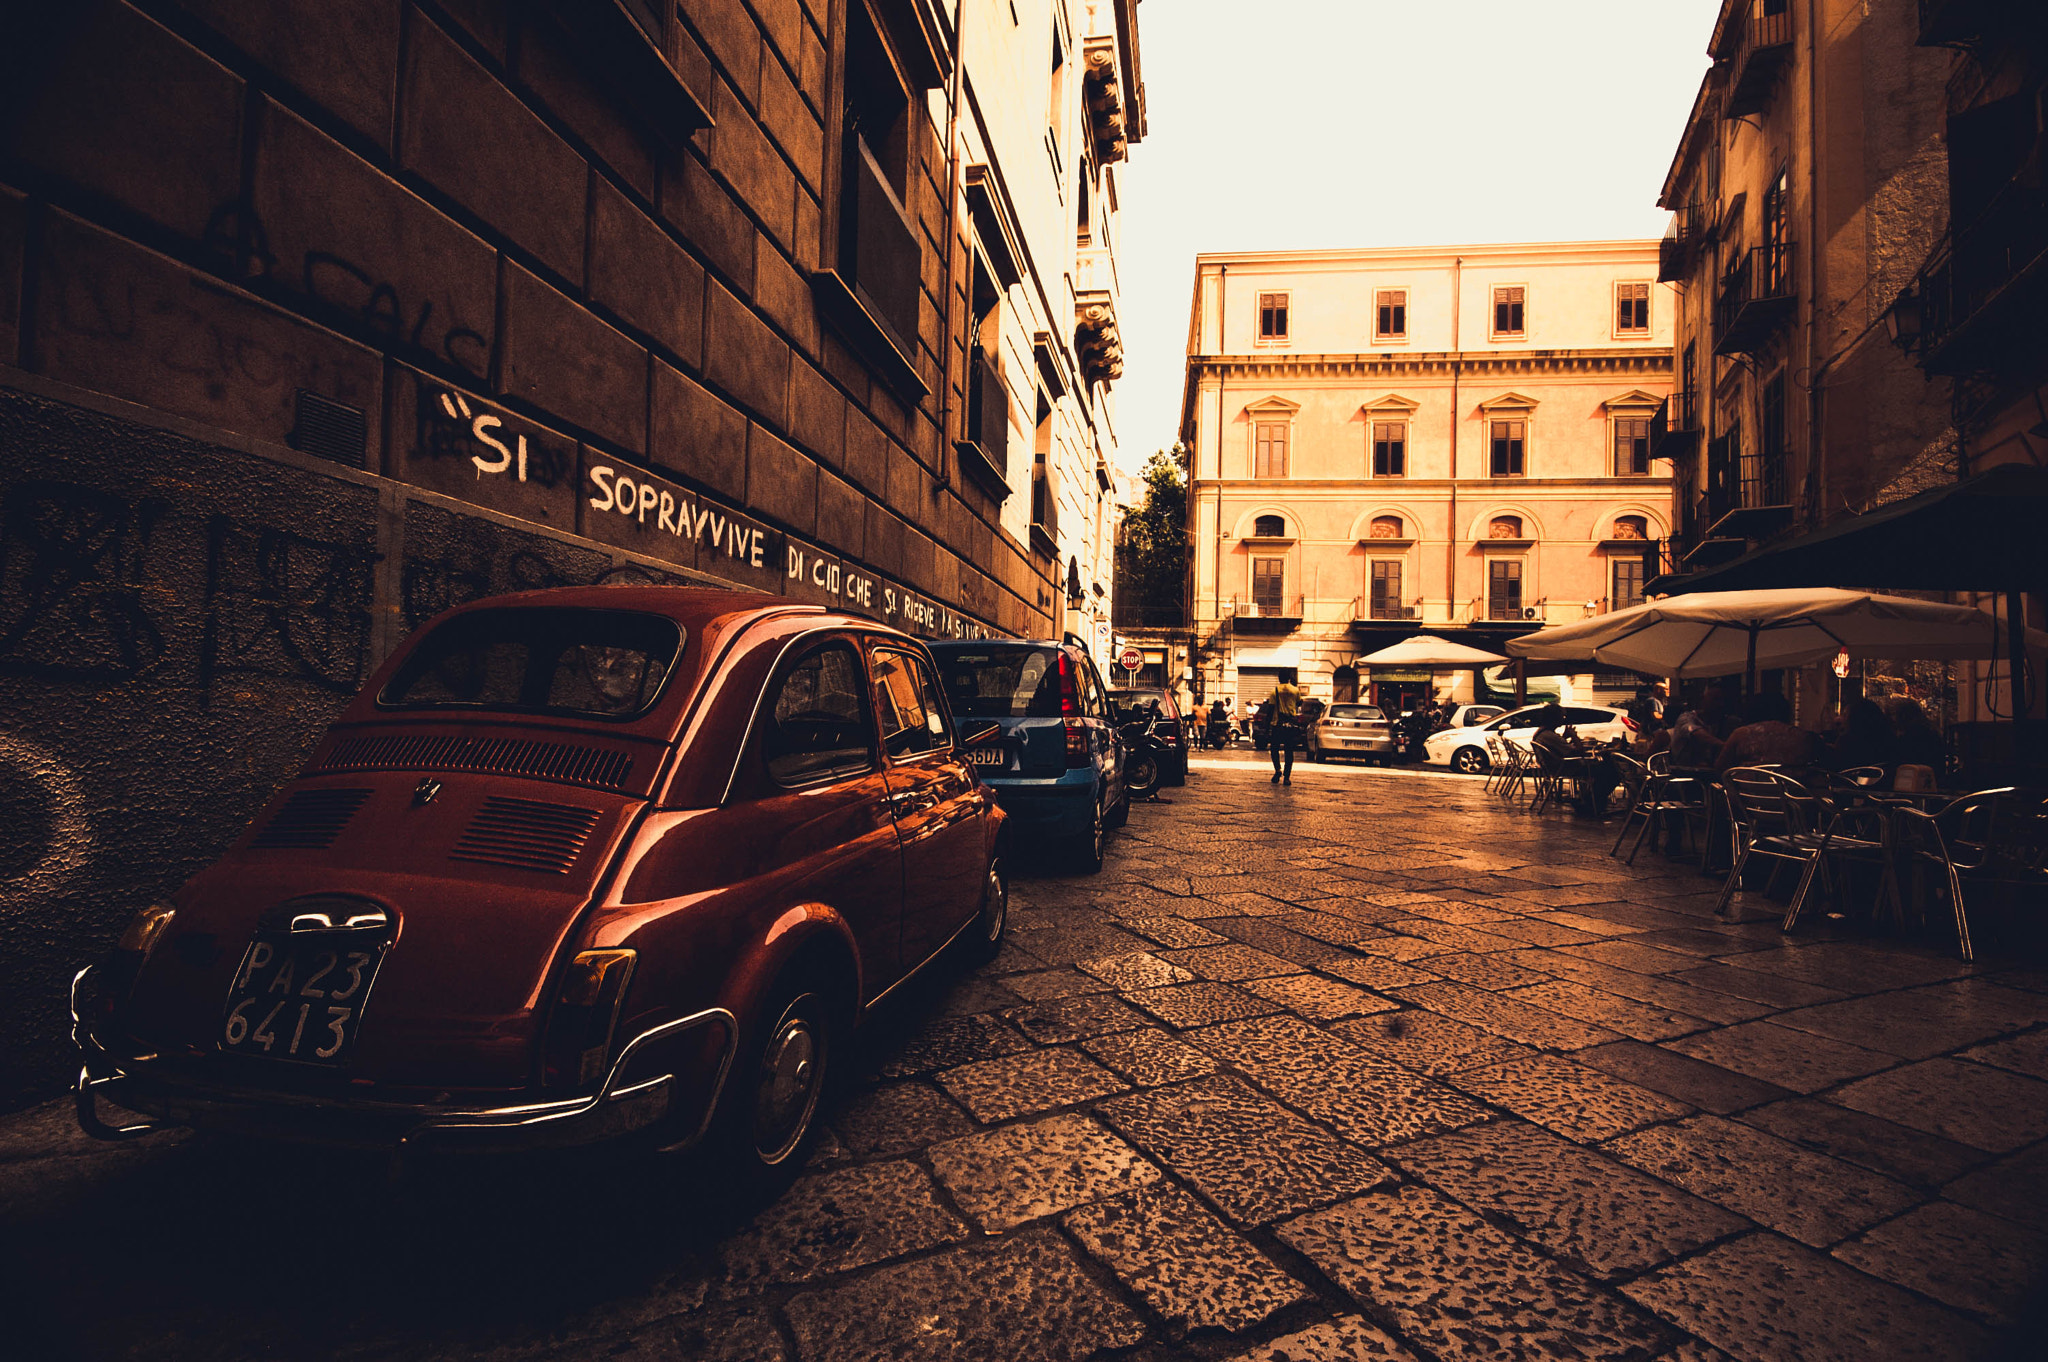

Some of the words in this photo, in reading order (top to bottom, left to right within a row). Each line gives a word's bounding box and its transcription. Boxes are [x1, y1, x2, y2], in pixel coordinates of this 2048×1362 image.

[589, 464, 765, 569] SOPRAVVIVE
[788, 545, 804, 582] DI
[846, 573, 873, 608] CHE
[904, 594, 934, 629] RICEVE
[1122, 656, 1139, 664] STOP
[225, 997, 353, 1059] 6413
